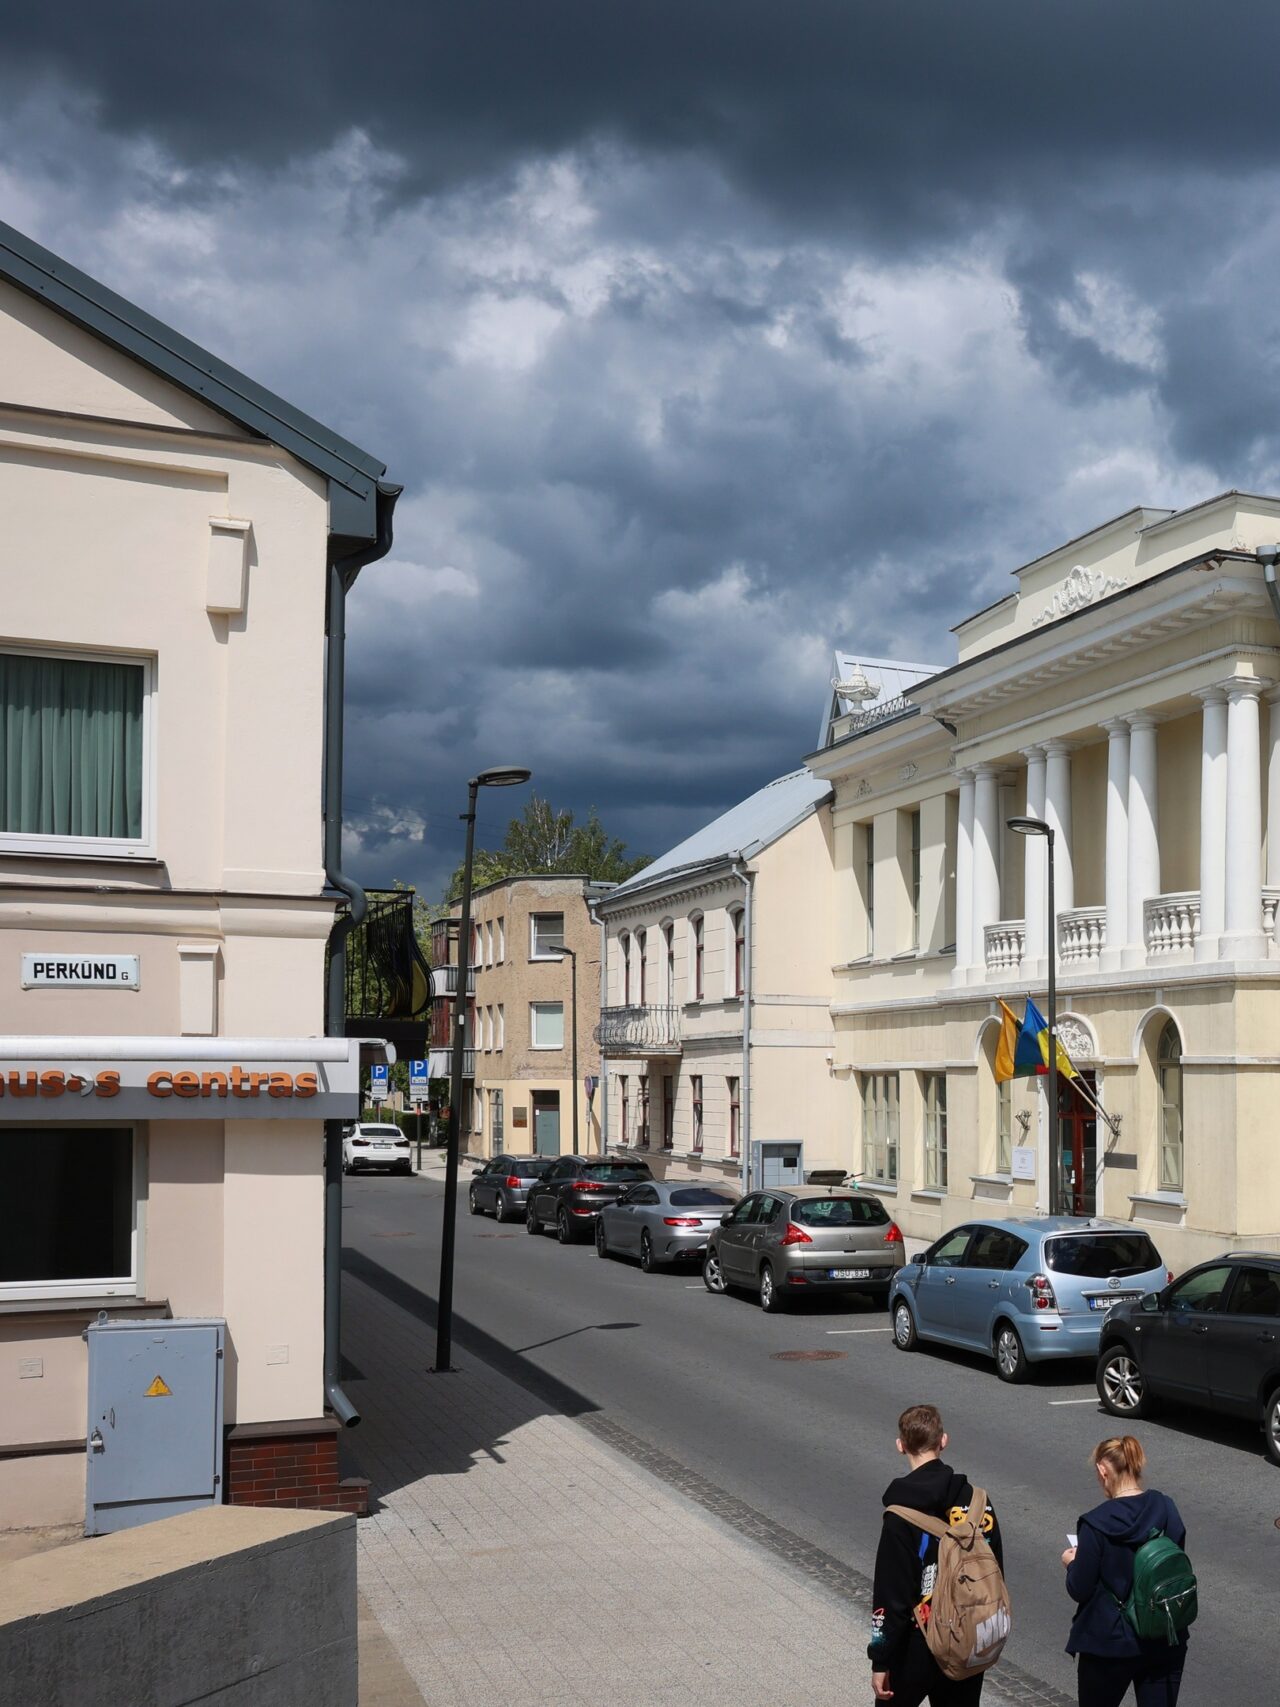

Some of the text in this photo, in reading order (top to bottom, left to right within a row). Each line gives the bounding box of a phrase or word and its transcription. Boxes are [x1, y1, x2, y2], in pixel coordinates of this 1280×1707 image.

[33, 960, 117, 980] PERKŪNO
[375, 1066, 384, 1077] P
[414, 1061, 424, 1074] P
[0, 1065, 317, 1098] usos centras
